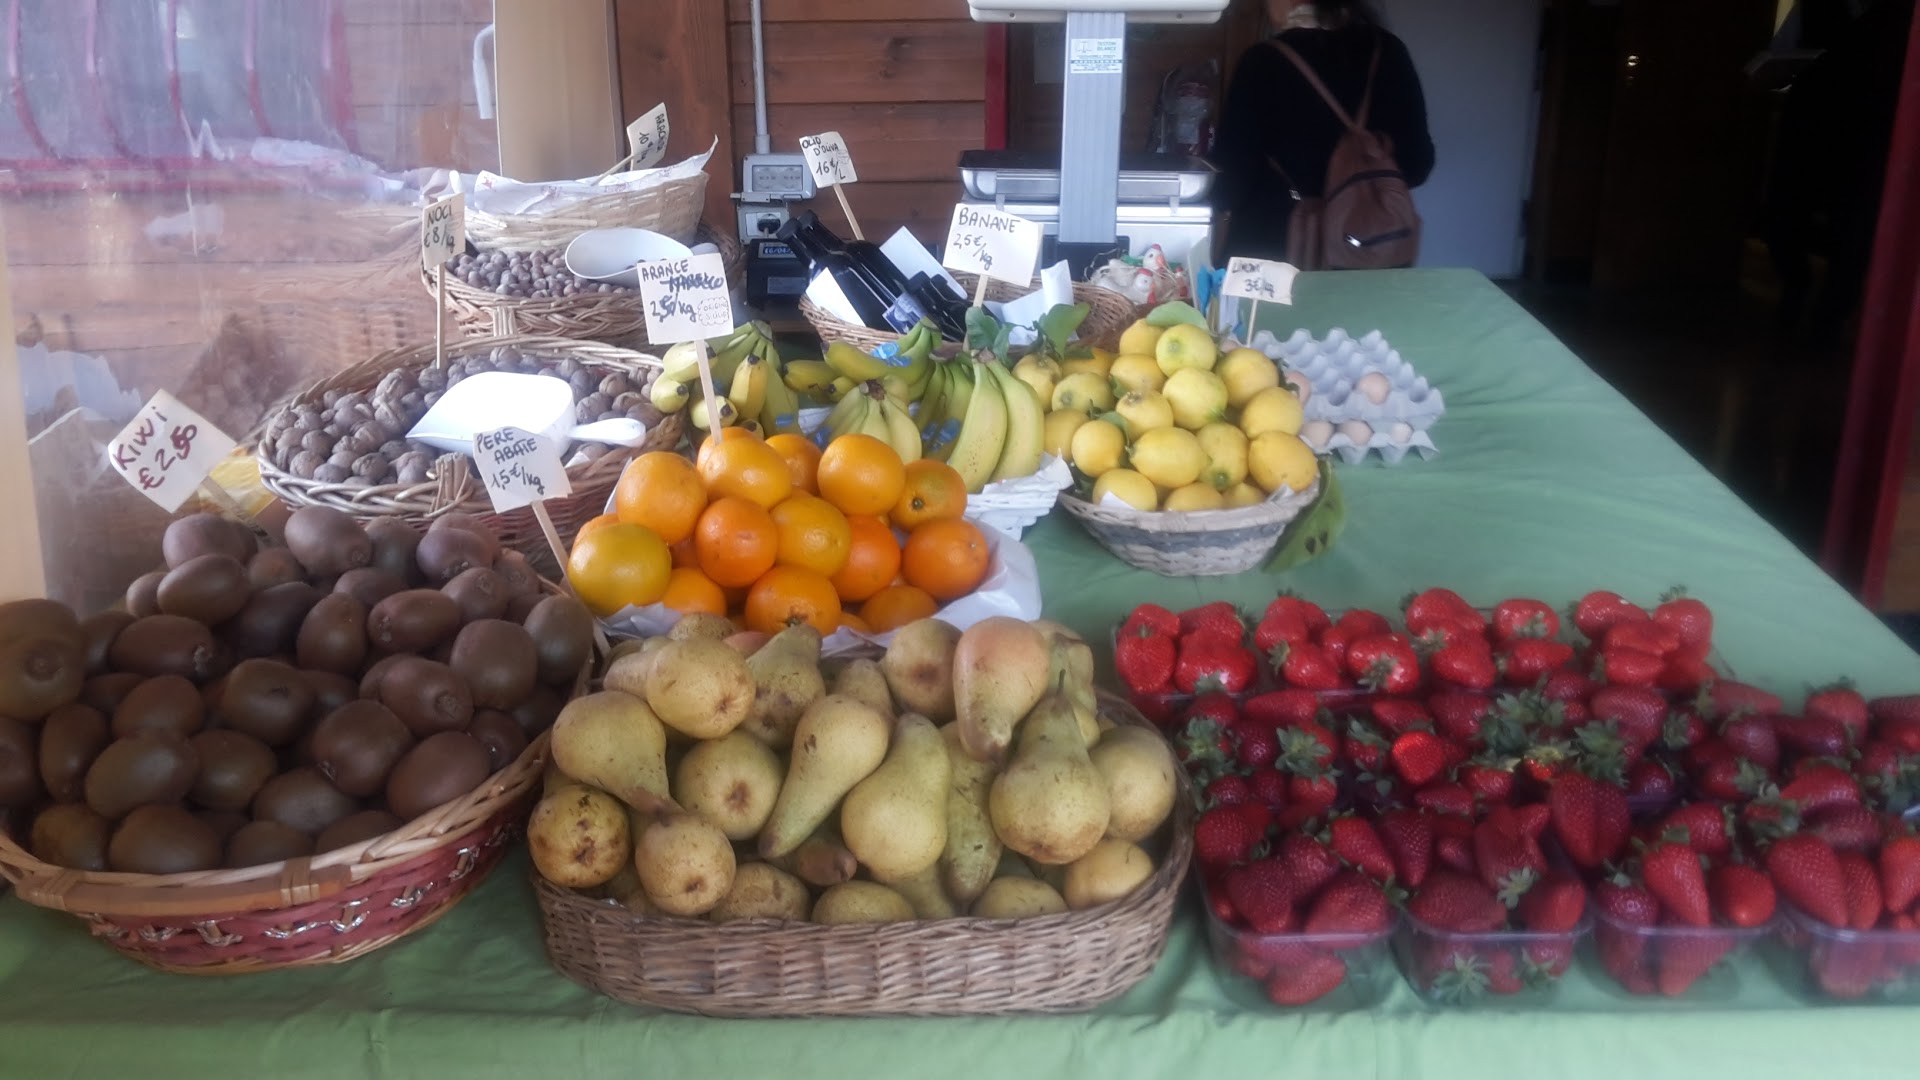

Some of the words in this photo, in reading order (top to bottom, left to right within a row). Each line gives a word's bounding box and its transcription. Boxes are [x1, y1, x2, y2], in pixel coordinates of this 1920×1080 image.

[958, 207, 1020, 233] BANANE
[642, 259, 689, 282] ARANCE
[476, 428, 515, 453] PERE
